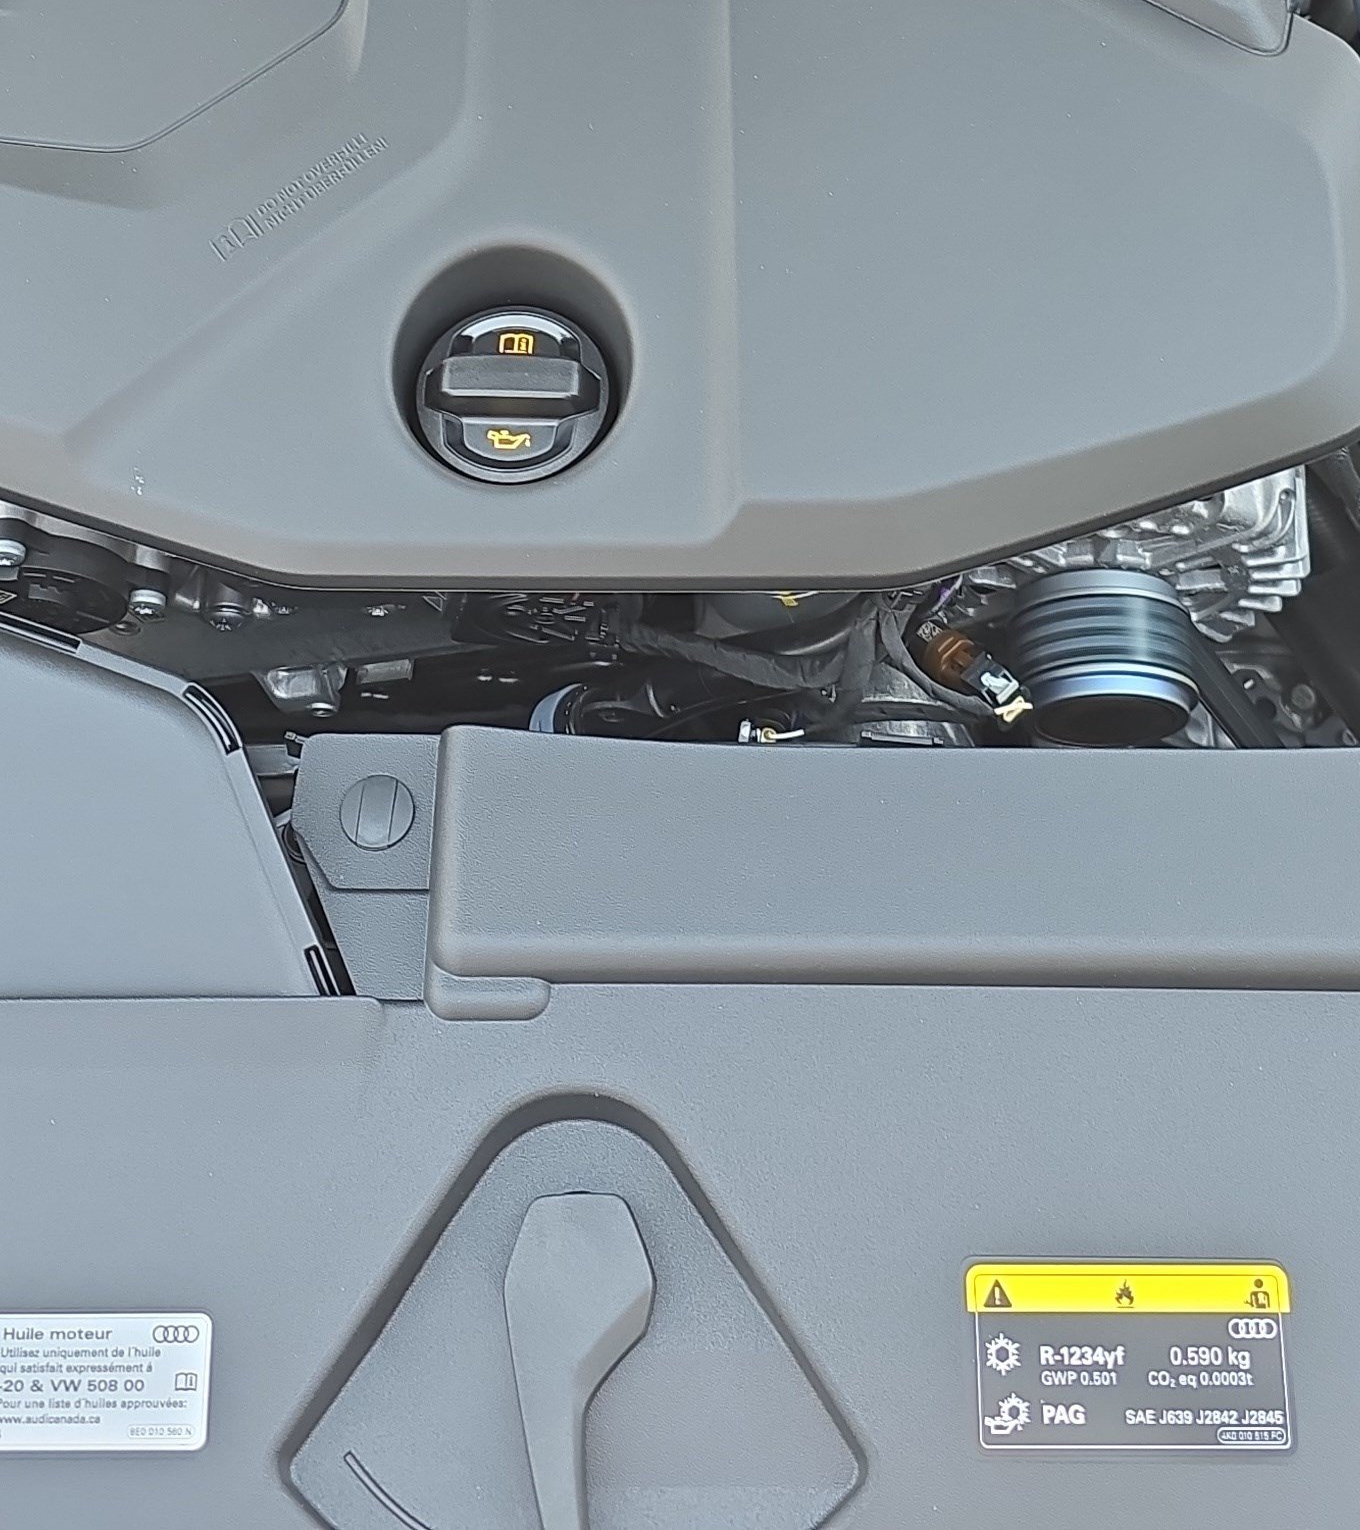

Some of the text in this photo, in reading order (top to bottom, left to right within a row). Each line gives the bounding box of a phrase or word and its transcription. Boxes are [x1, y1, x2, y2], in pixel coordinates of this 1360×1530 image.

[3, 1328, 113, 1340] Huile moteur
[1, 1347, 162, 1360] Utilisez uniquement de l'huile
[1040, 1346, 1126, 1369] R-1234yf
[1170, 1346, 1251, 1370] 0.590 kg
[0, 1363, 18, 1375] qui
[20, 1363, 64, 1374] satisfait
[66, 1362, 144, 1375] expressément
[1041, 1371, 1118, 1386] GWP 0.501
[1178, 1373, 1198, 1388] eq
[1200, 1371, 1255, 1386] 0.0003t
[30, 1379, 44, 1393] &
[51, 1379, 82, 1393] VW
[87, 1379, 119, 1393] 508
[124, 1379, 146, 1393] 00
[24, 1400, 45, 1409] une
[48, 1398, 71, 1409] liste
[74, 1398, 118, 1409] d'huiles
[120, 1398, 188, 1412] approuvées:
[1042, 1405, 1087, 1425] PAG
[1125, 1410, 1285, 1425] SAE J639 J2842 J2845
[1239, 1431, 1253, 1440] 010
